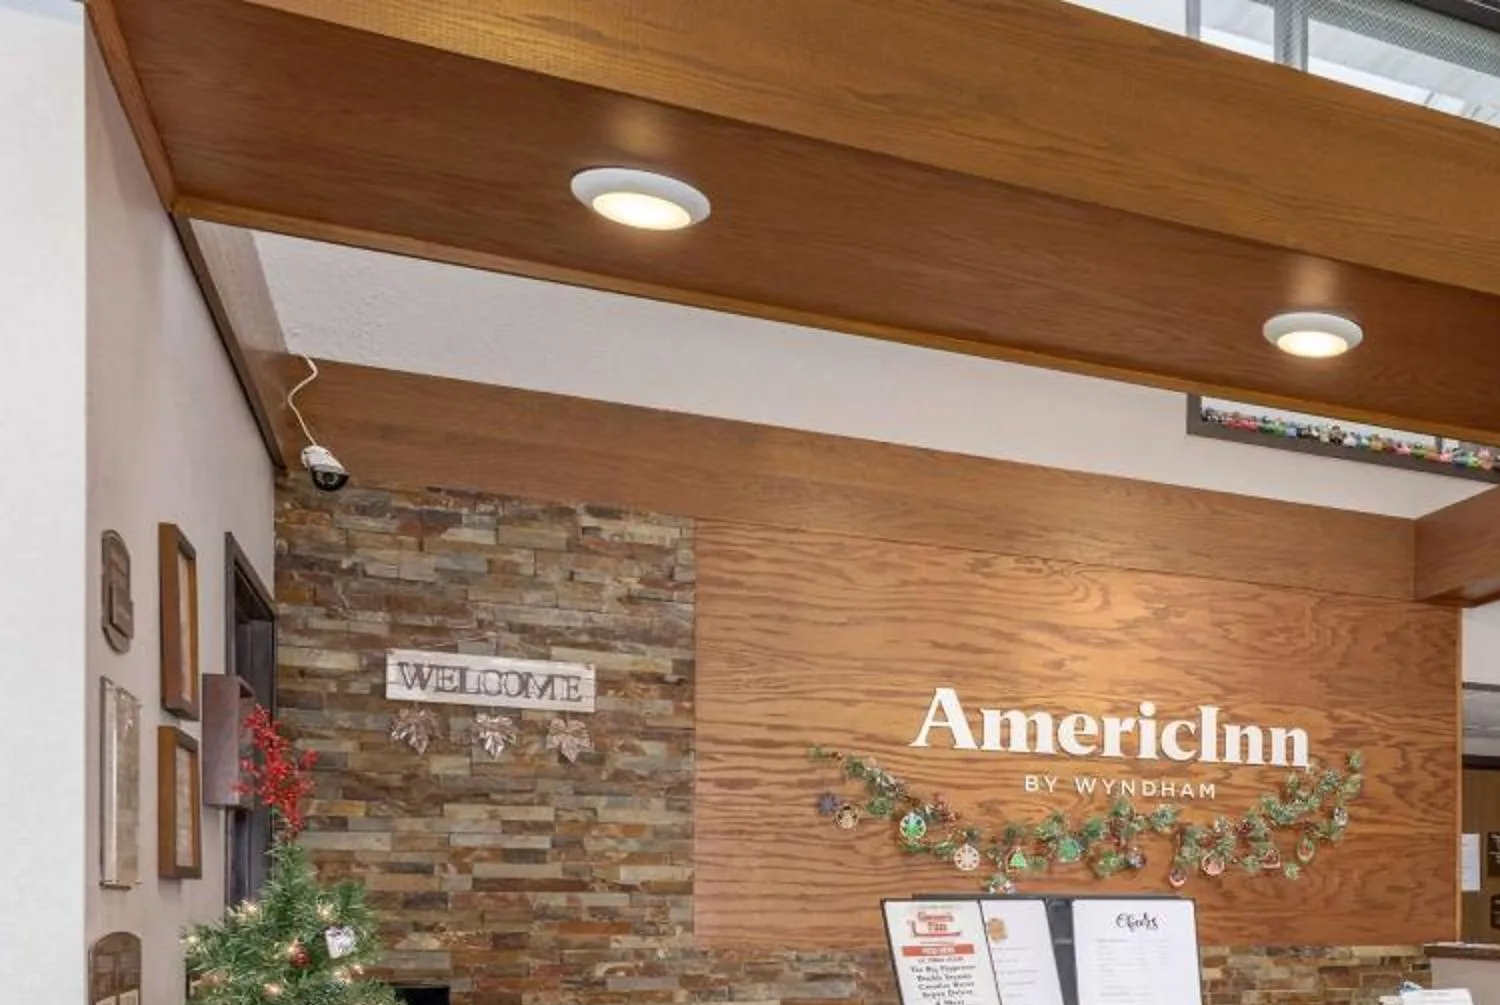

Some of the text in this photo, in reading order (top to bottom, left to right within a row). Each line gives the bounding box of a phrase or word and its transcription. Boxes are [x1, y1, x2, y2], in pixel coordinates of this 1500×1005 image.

[398, 662, 582, 702] WELCOME
[907, 687, 1311, 768] AmericInn
[1024, 774, 1217, 800] BY WYNDHAM
